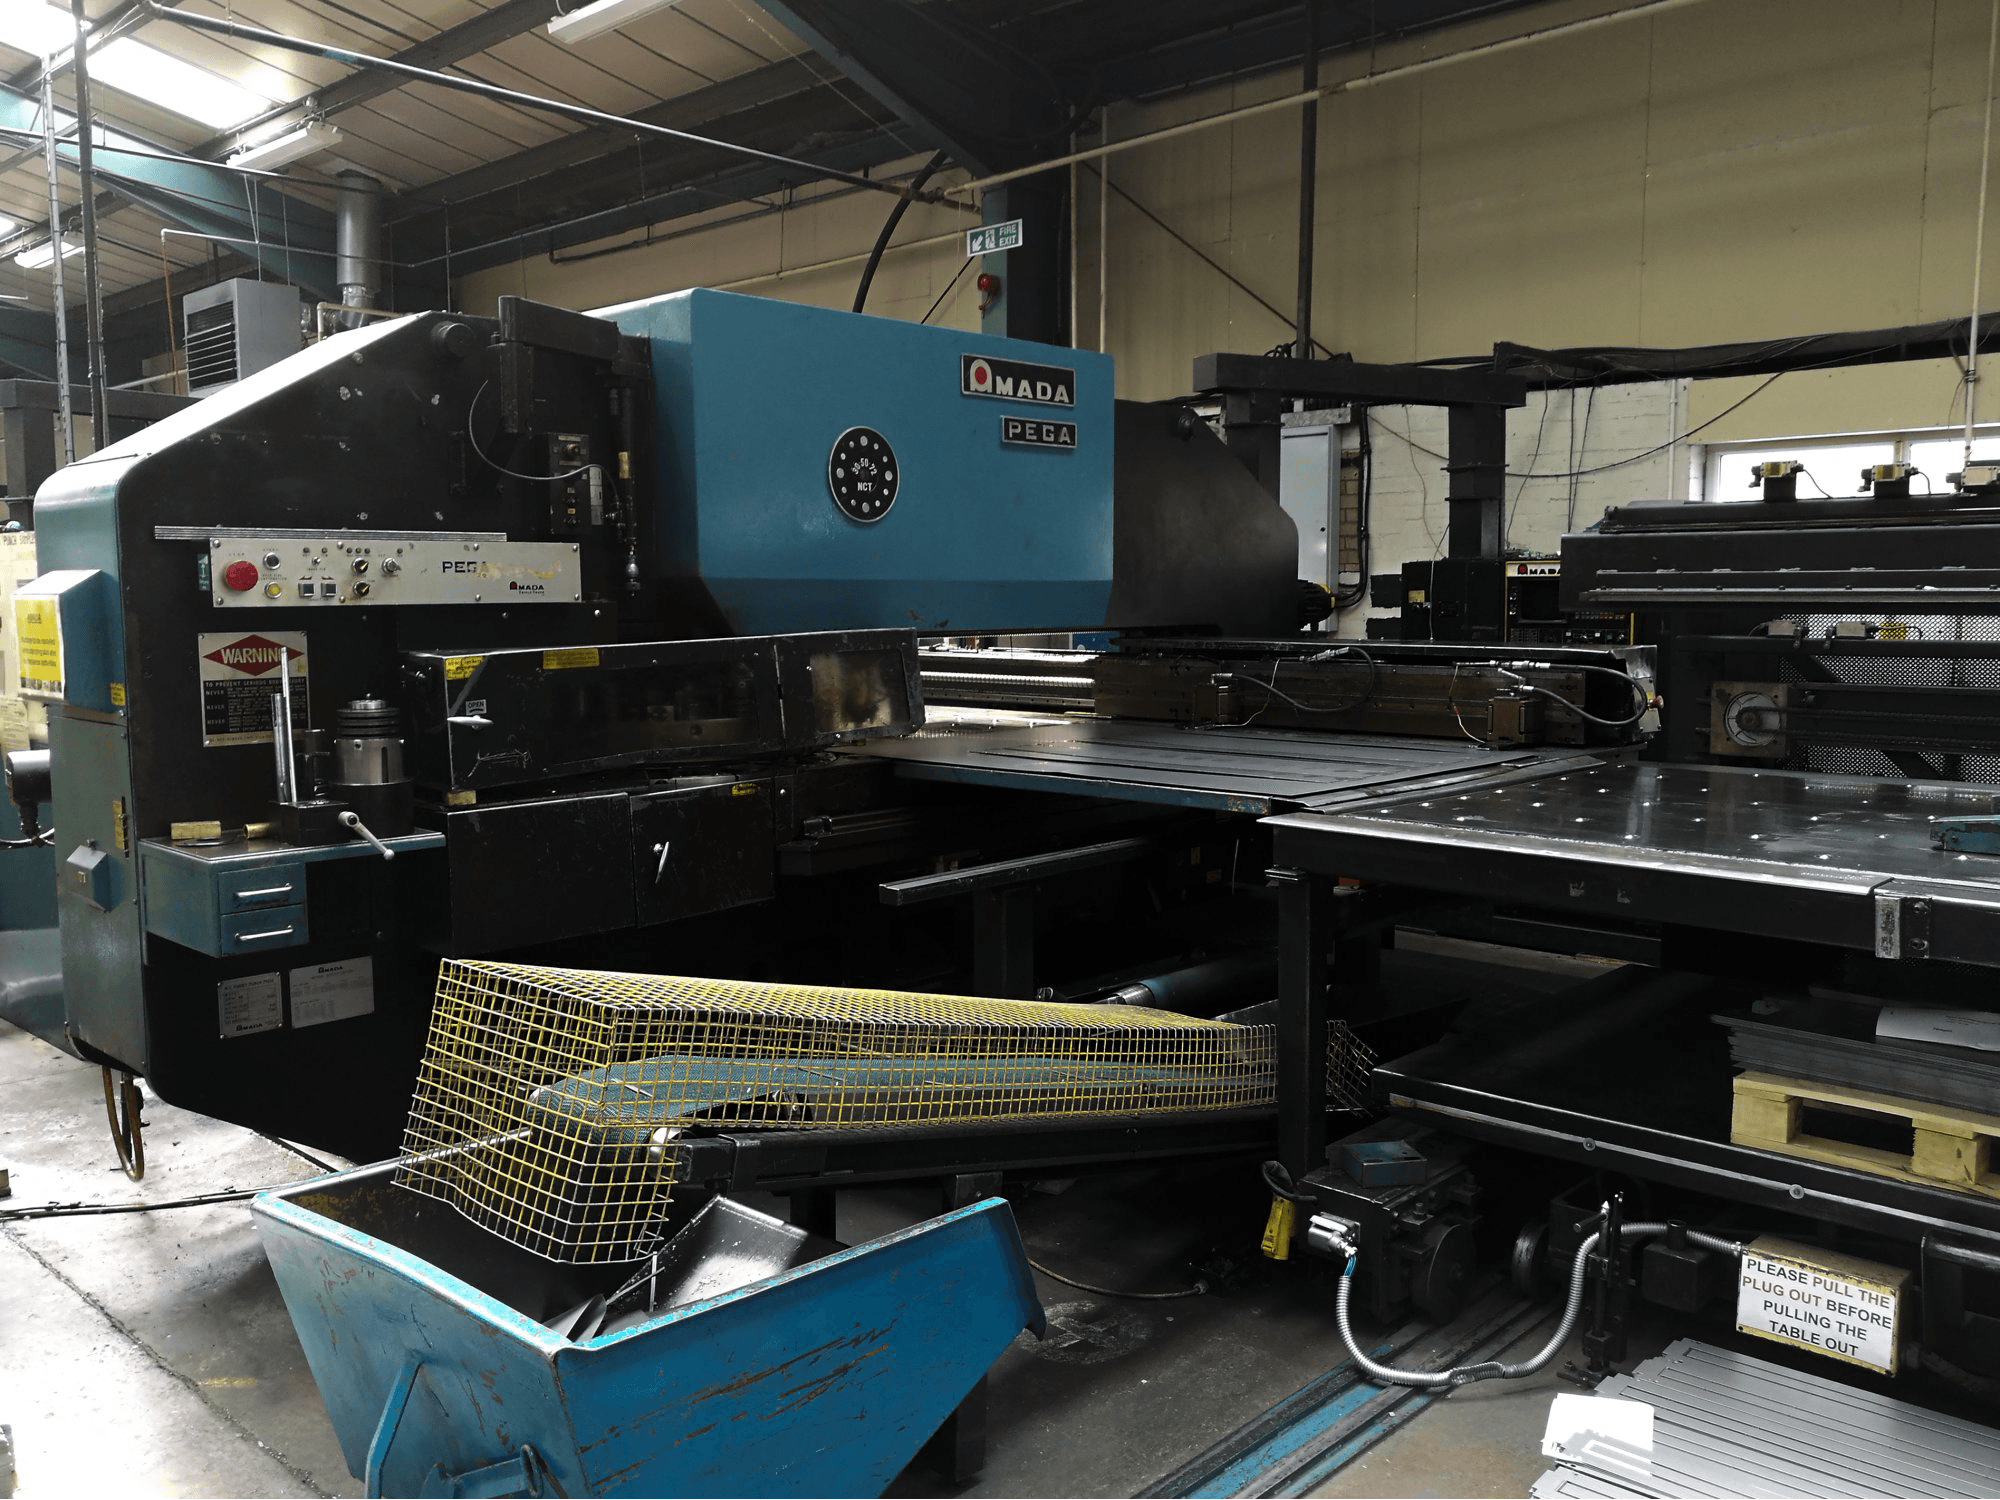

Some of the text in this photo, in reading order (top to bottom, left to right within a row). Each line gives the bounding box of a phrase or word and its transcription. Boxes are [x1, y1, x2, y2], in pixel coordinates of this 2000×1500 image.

[998, 223, 1018, 237] FIRE
[999, 234, 1018, 247] EXIT
[969, 358, 1070, 404] AMADA
[1008, 421, 1072, 444] PEGA
[857, 482, 873, 492] NCT
[510, 581, 544, 591] AMADA
[221, 647, 284, 664] WARNIN
[467, 701, 485, 709] OPEN
[1747, 1258, 1891, 1309] PLEASE PULL THE
[1742, 1275, 1893, 1330] PLUG OUT BEFORE
[1763, 1299, 1868, 1341] PULLING THE
[1769, 1319, 1859, 1356] TABLE OUT
